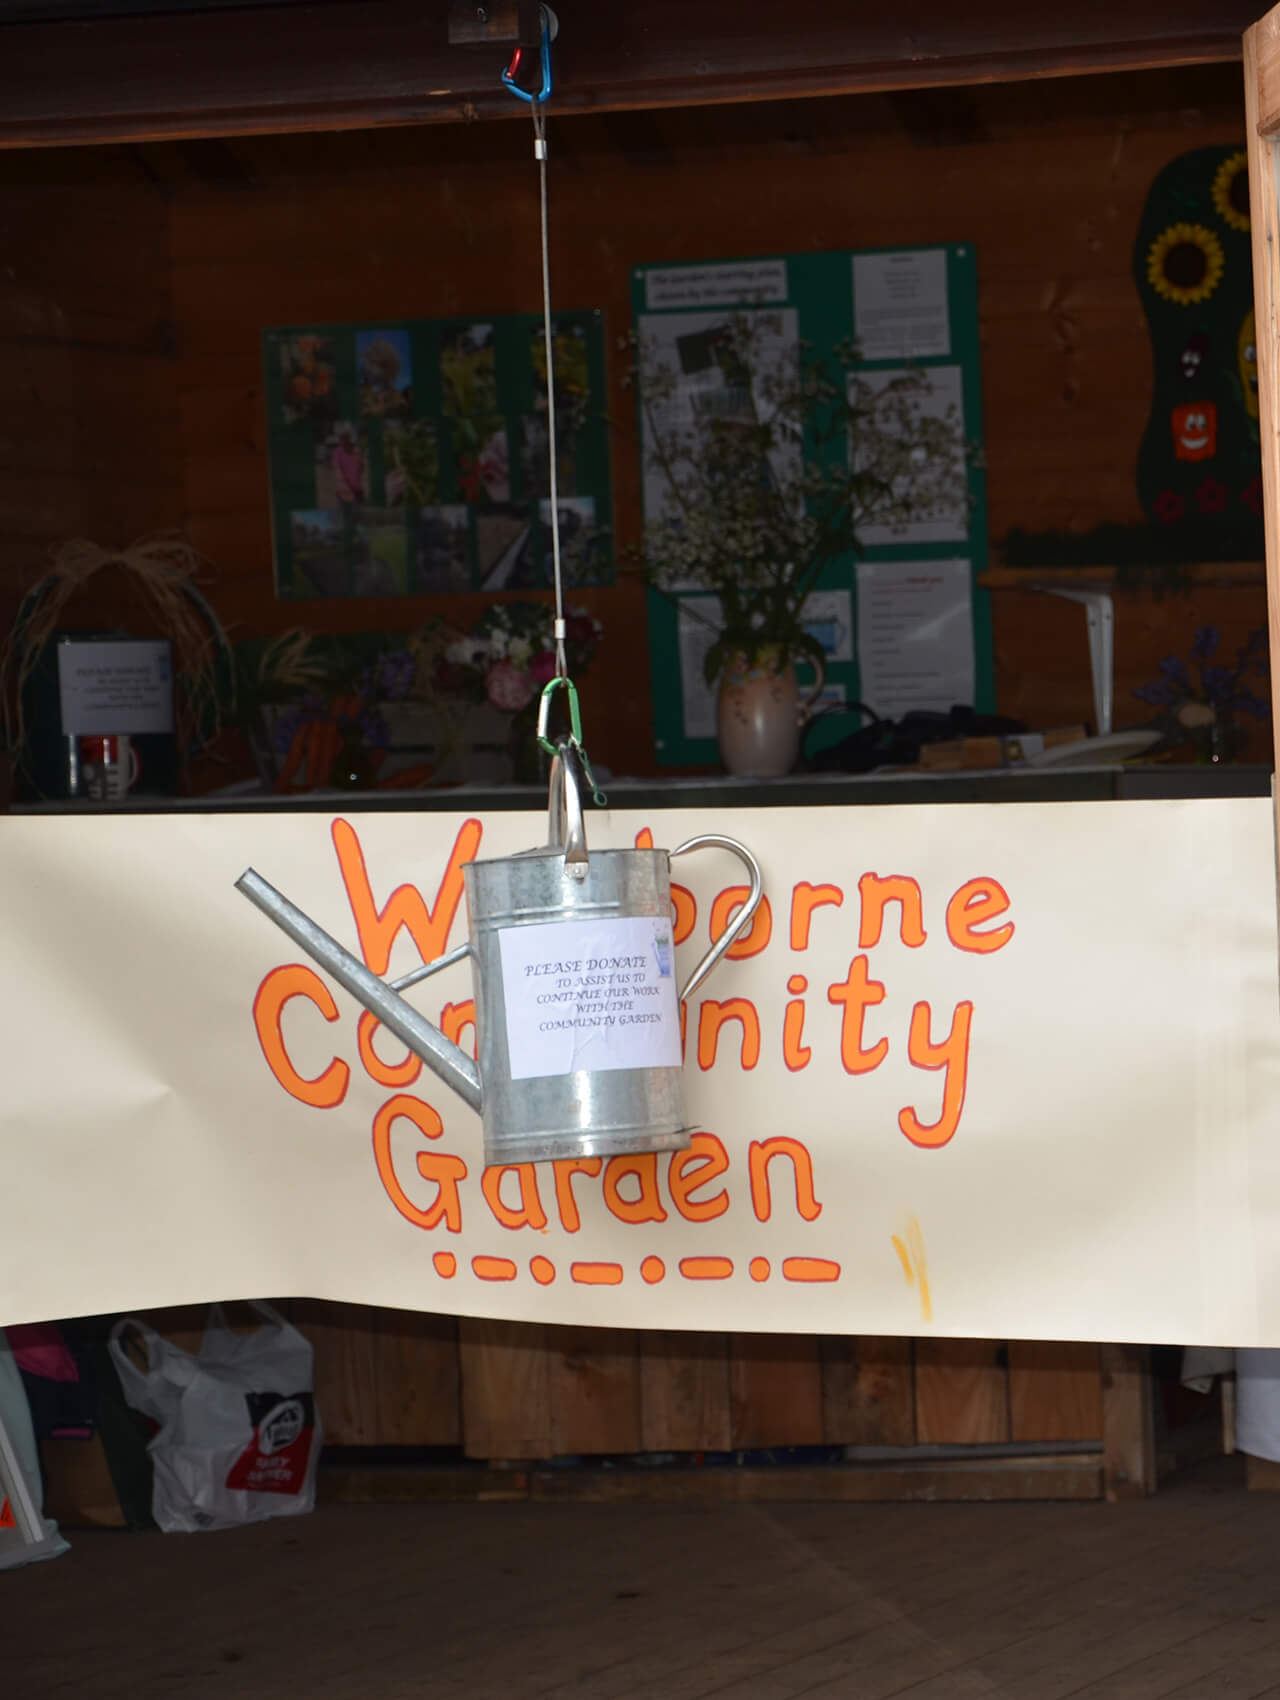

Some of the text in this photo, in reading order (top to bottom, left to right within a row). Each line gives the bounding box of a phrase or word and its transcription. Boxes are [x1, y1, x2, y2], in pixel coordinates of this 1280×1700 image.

[524, 956, 647, 977] PLEASE DONATE
[555, 973, 647, 988] TO ASSIST US TO
[536, 986, 661, 1005] CONTINUE OUR WORK
[576, 1000, 635, 1014] WITH THE
[539, 1013, 663, 1032] COMMUNITY GARDEN
[372, 1094, 822, 1232] Garden
